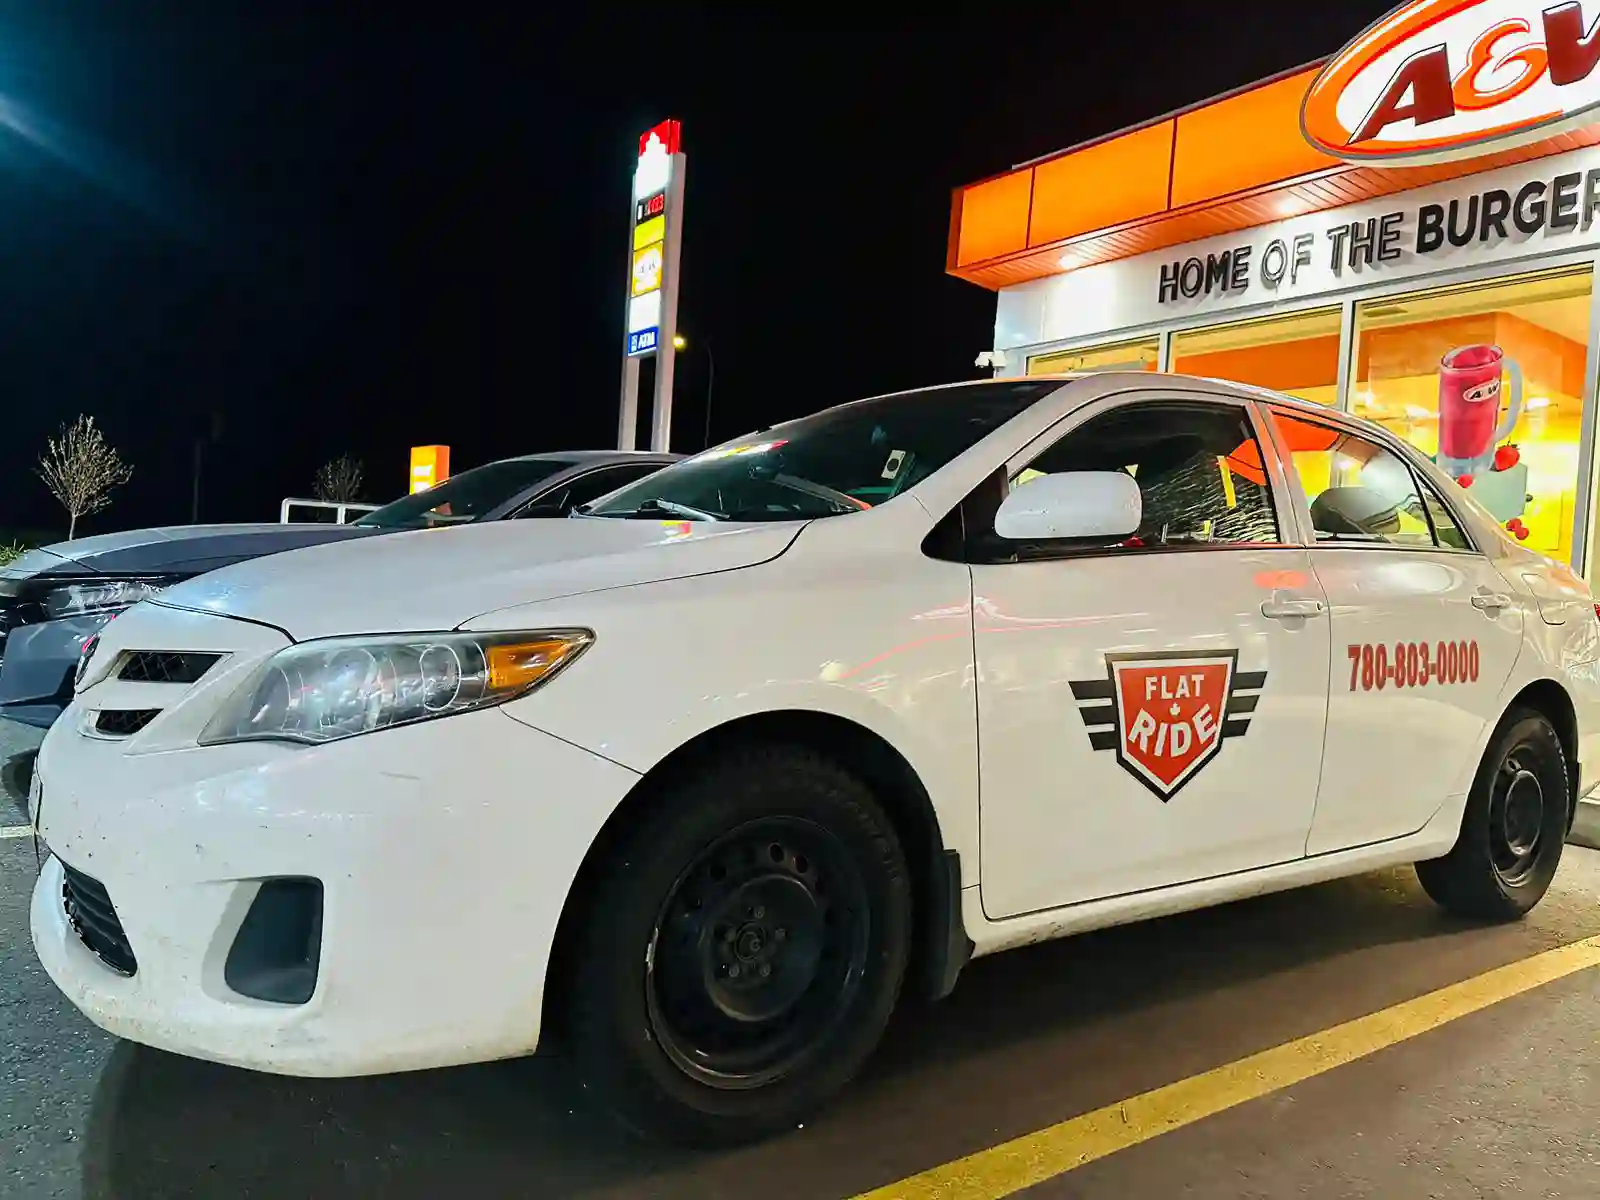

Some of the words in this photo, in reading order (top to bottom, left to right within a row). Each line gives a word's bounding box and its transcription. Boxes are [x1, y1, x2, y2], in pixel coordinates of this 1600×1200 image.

[1158, 245, 1253, 304] HOME
[1260, 232, 1315, 286] OF
[1326, 211, 1404, 271] THE
[1470, 382, 1499, 400] AW
[1145, 674, 1205, 700] FLAT
[1347, 640, 1479, 692] 780-803-0000
[1127, 703, 1218, 758] RIDE
